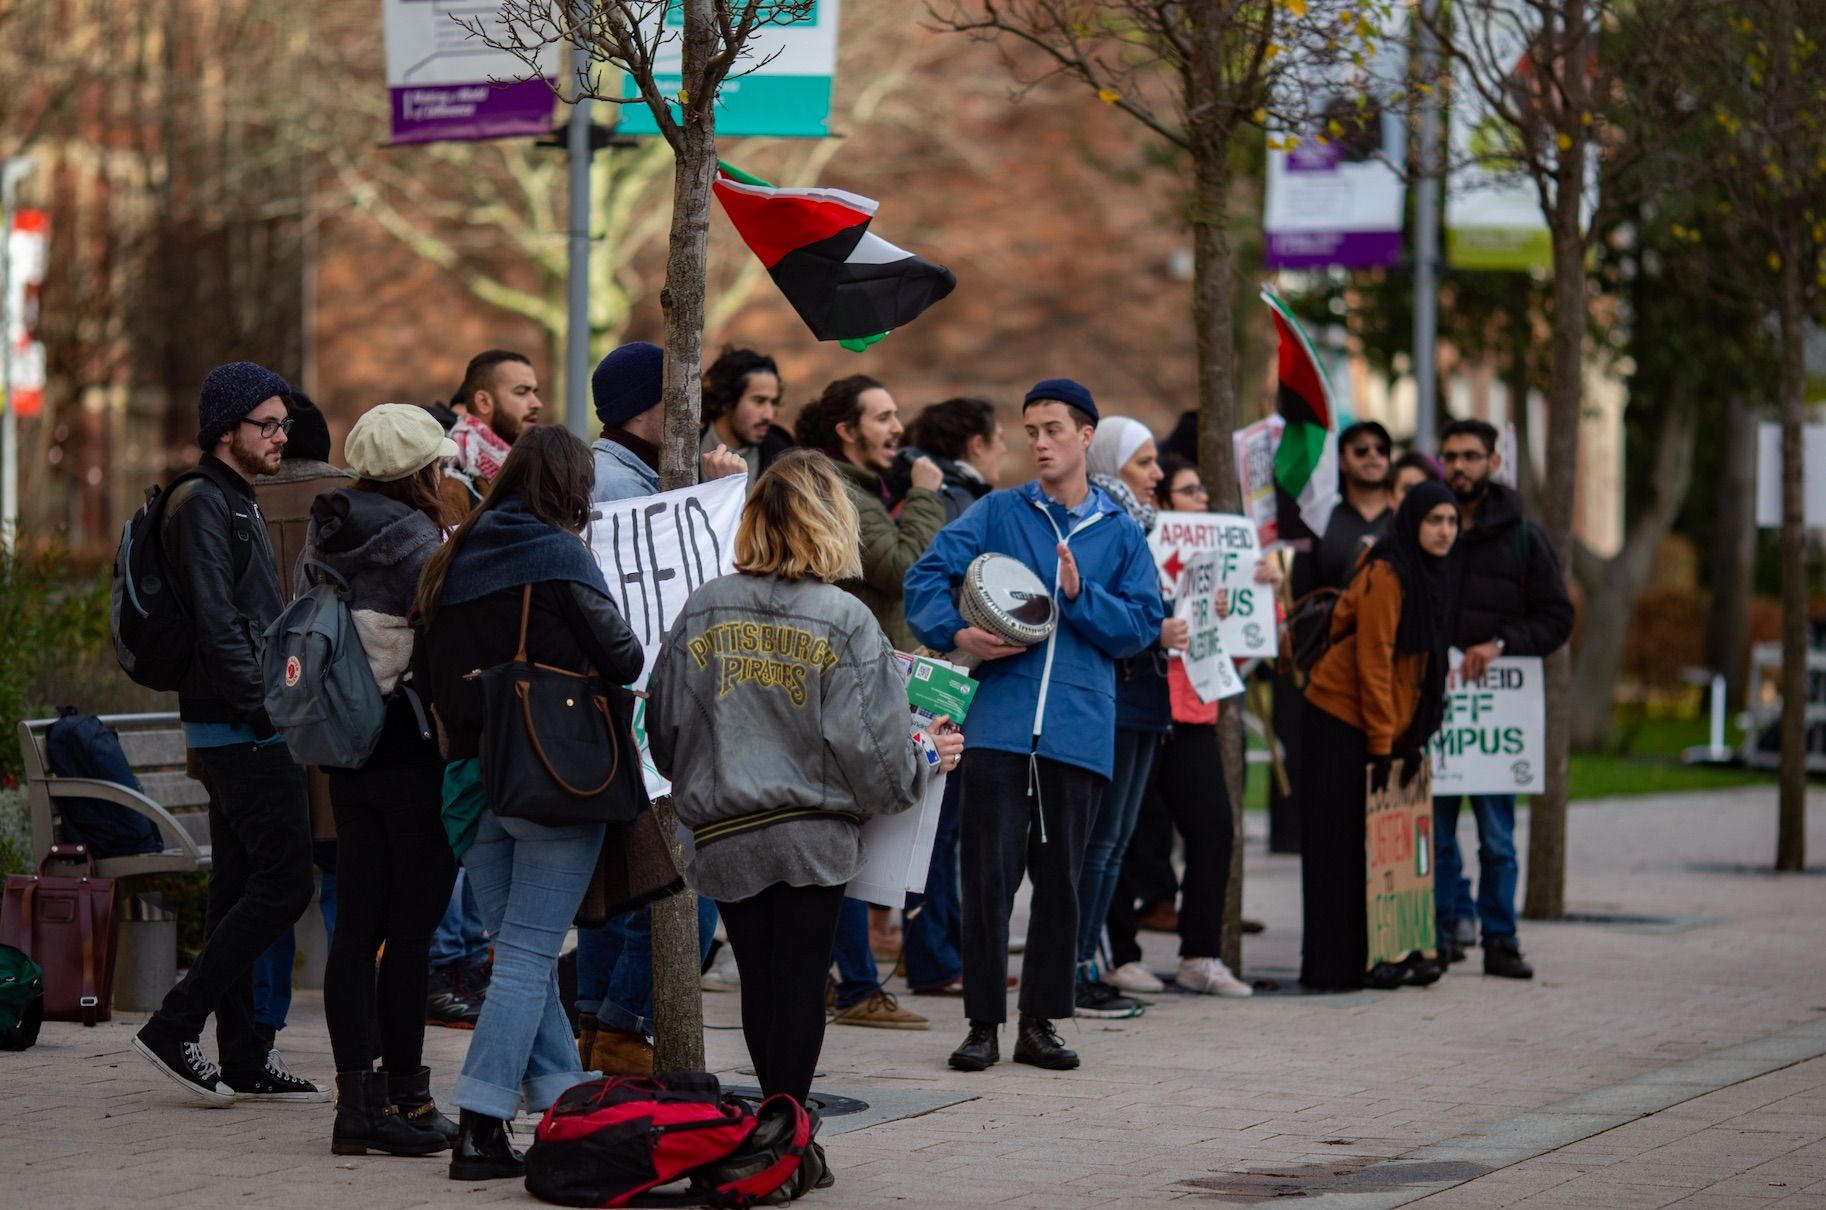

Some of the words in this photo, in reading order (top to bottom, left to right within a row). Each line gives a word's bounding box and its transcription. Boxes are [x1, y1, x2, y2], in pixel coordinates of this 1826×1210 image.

[1160, 523, 1254, 549] APARTHEID
[720, 654, 808, 709] PIRATES
[1445, 692, 1494, 722] FF
[1424, 727, 1524, 757] MPUS
